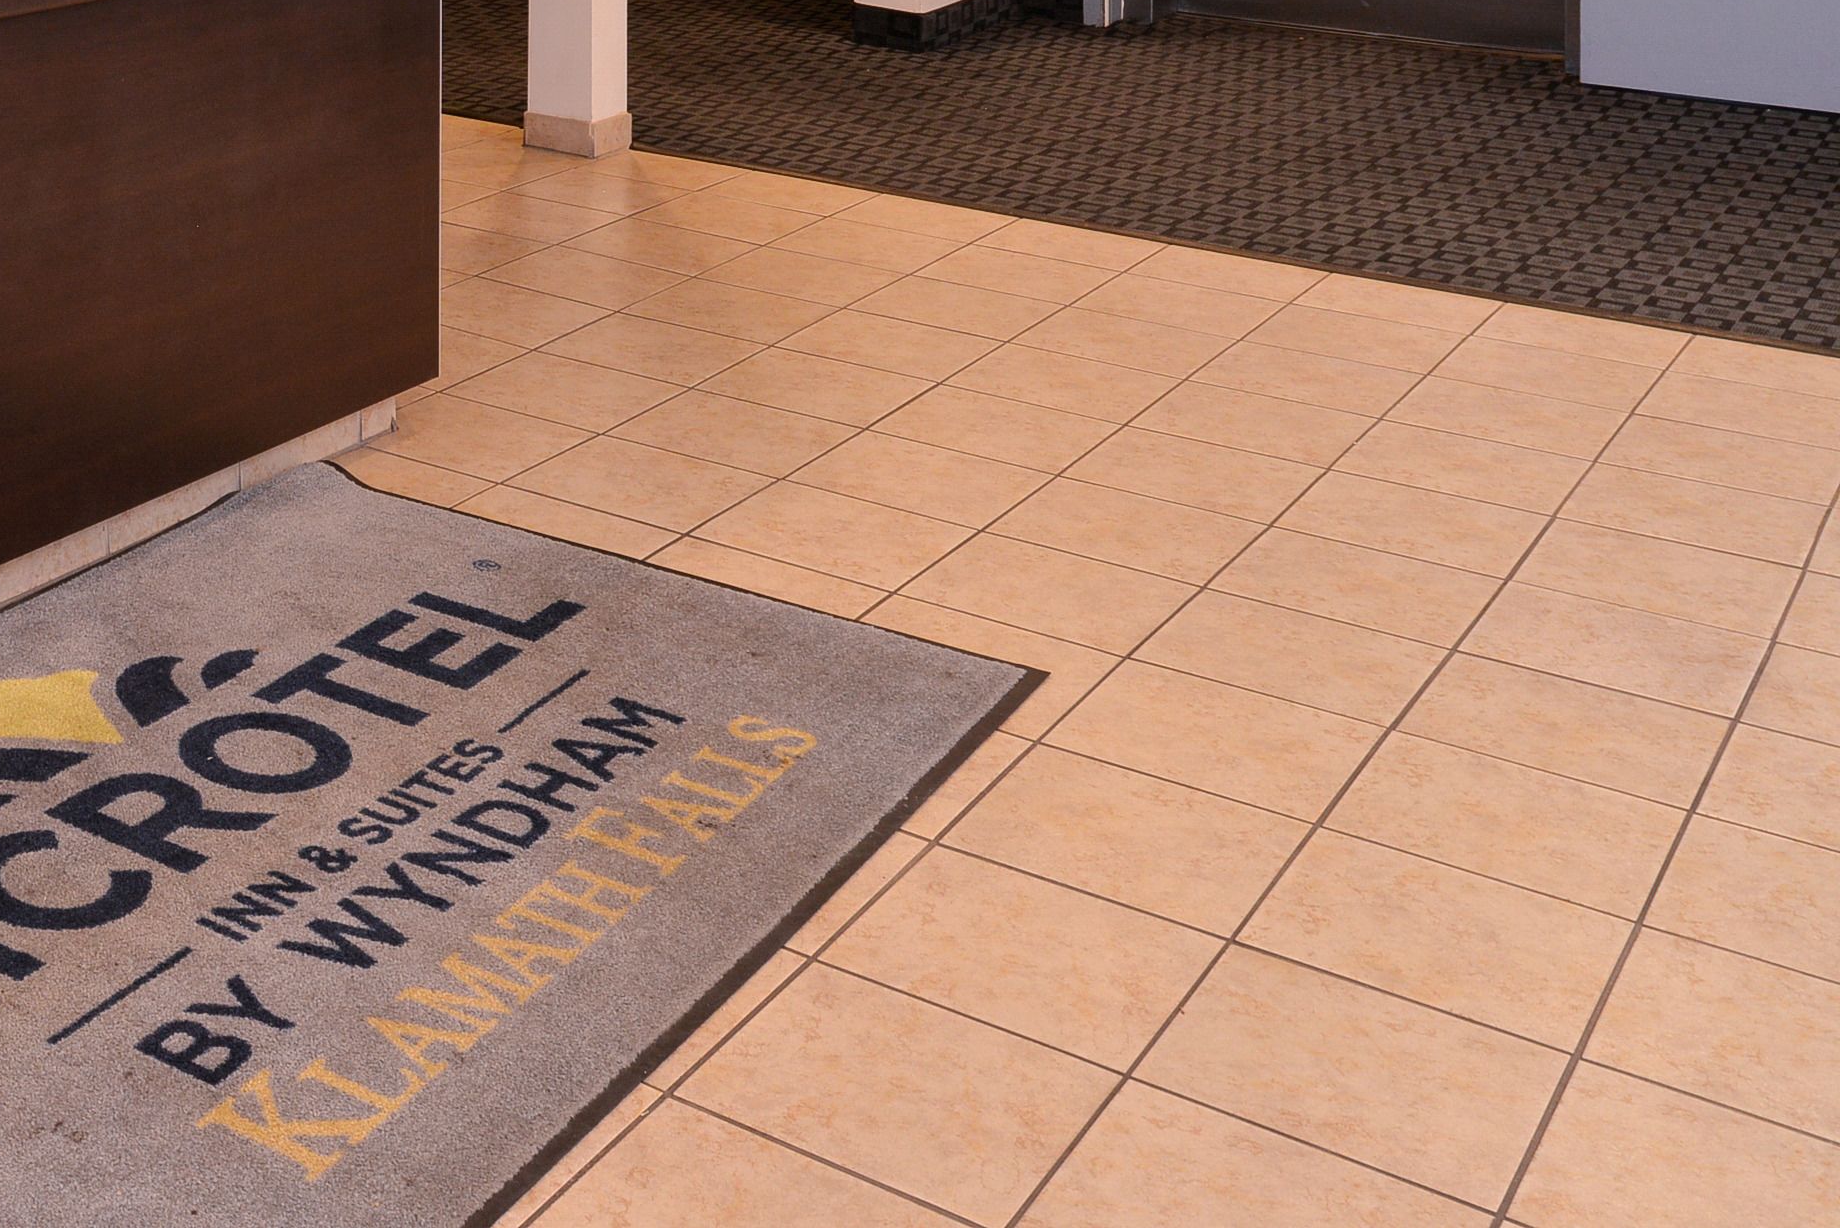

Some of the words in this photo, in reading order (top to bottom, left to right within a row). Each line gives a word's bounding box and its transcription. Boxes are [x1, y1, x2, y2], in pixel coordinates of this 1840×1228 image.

[134, 975, 295, 1087] BY
[277, 697, 687, 969] WYNDHAM
[196, 871, 316, 942] INN
[298, 843, 358, 874] &
[340, 738, 507, 846] SUITES
[196, 861, 657, 1182] KLAMATH
[568, 715, 819, 875] FALLS
